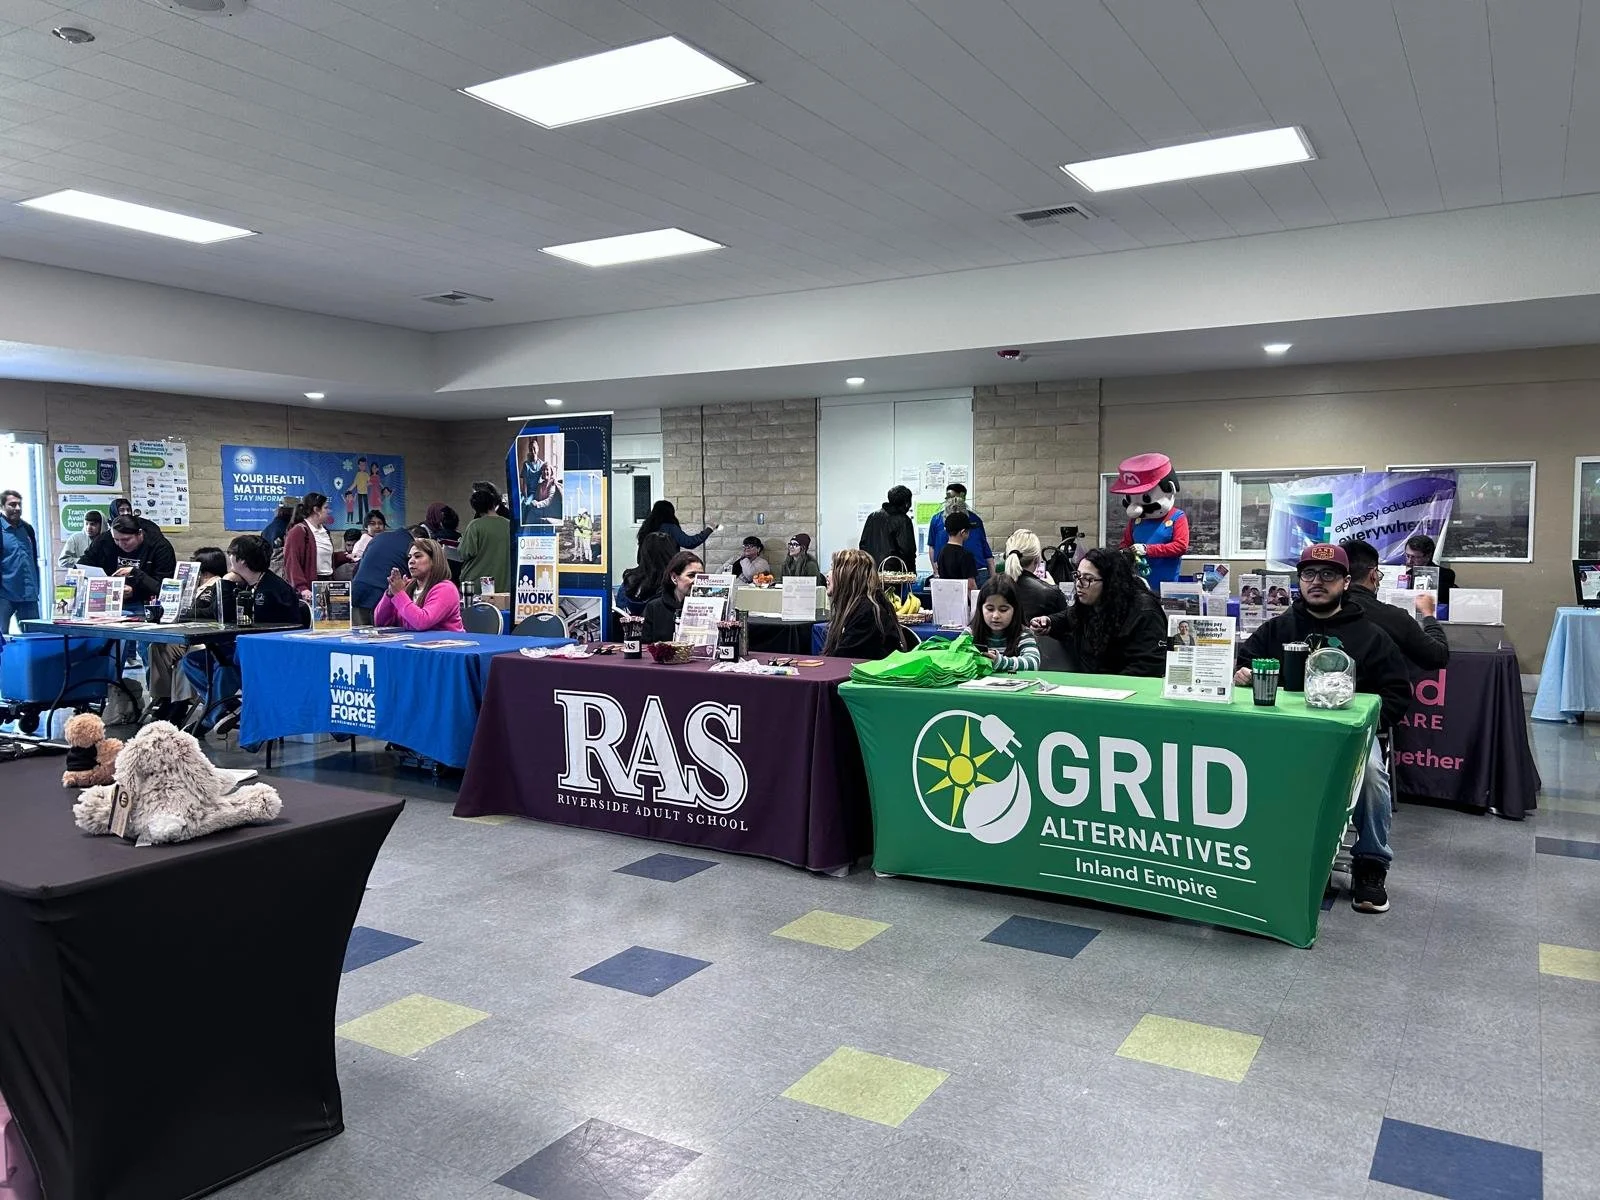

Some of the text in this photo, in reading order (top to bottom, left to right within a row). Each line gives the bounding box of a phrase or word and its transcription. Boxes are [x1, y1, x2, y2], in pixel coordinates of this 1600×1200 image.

[233, 473, 305, 485] YOUR HEALTH
[234, 484, 287, 494] MATTERS:
[1123, 472, 1140, 485] M
[1335, 509, 1380, 533] epilepsy
[518, 593, 553, 604] WORK
[330, 688, 375, 708] WORK
[331, 704, 376, 724] FORCE
[553, 689, 749, 814] RAS
[1037, 731, 1248, 830] GRID
[557, 793, 748, 832] RIVERSIDE ADULT SCHOOL
[1041, 816, 1251, 871] ALTERNATIVES
[1075, 857, 1218, 899] Inland Empire
